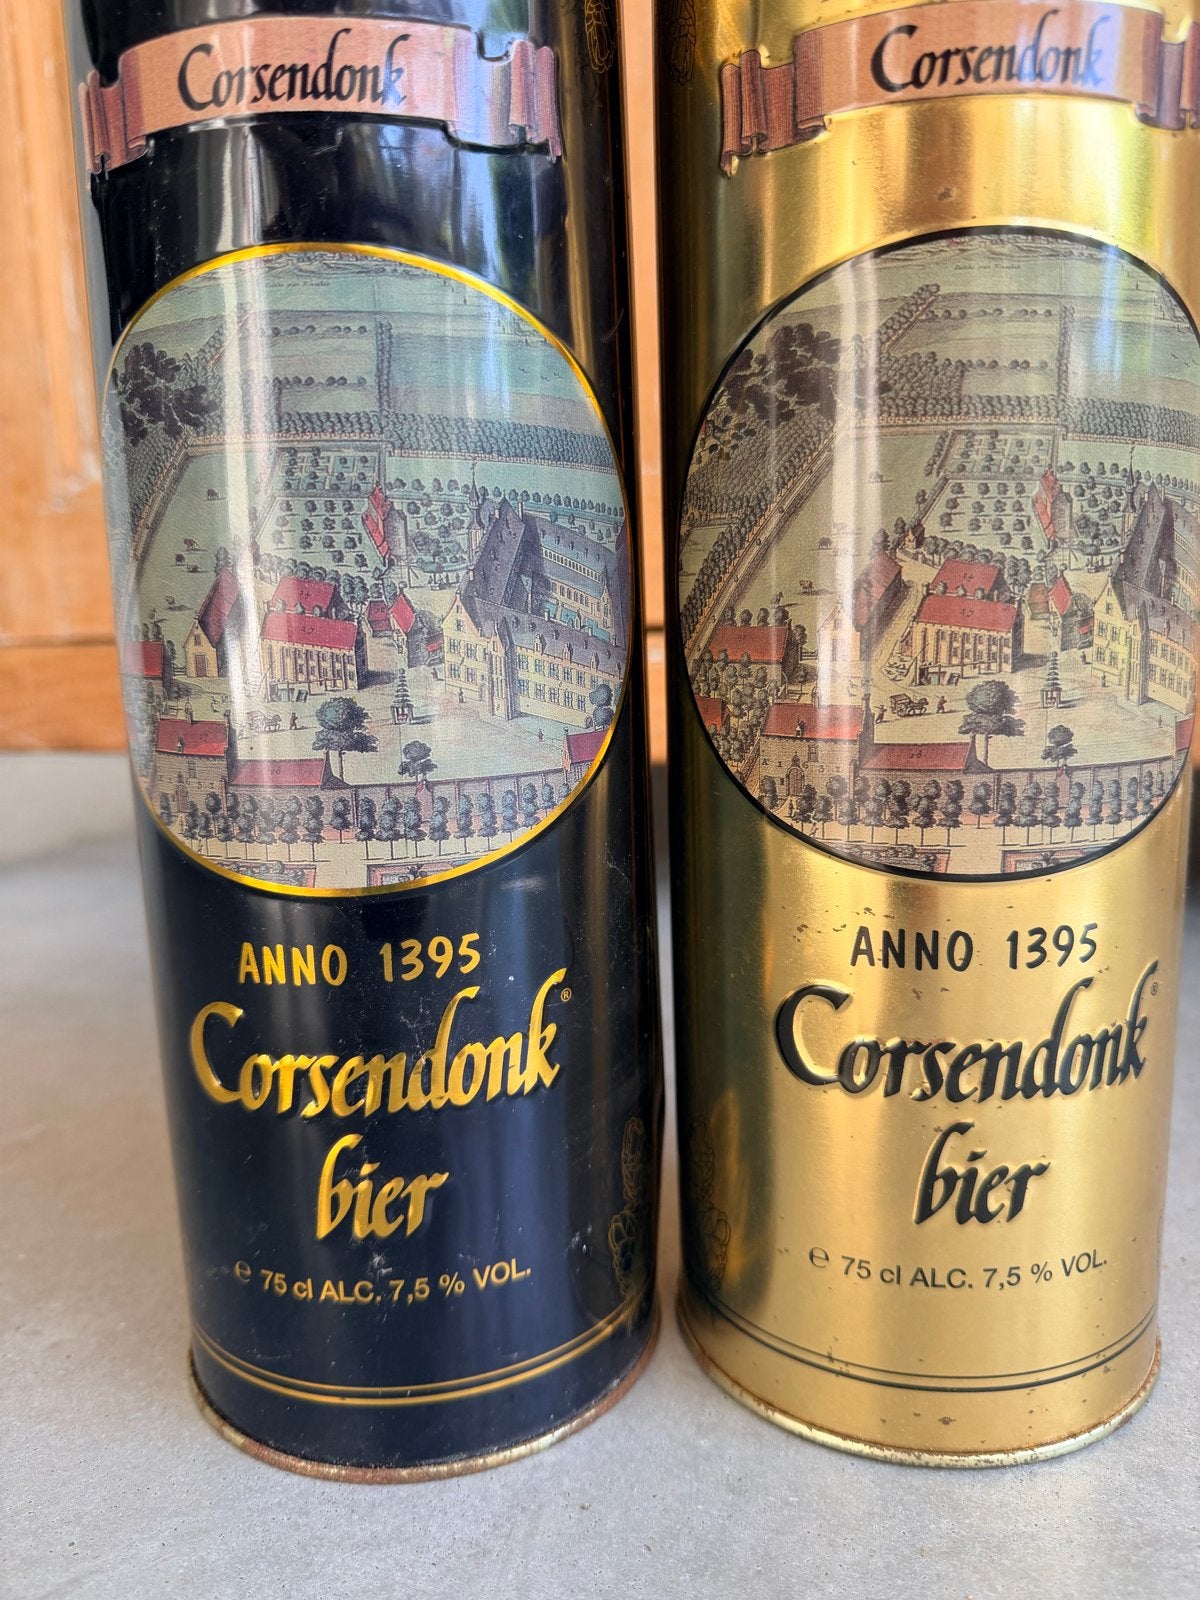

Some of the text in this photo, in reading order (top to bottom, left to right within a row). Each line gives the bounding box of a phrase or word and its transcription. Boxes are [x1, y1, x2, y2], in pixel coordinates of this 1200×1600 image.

[177, 28, 411, 112] Corsendonk
[869, 9, 1113, 93] Corsendonk
[238, 932, 482, 987] ANNO 1395
[850, 922, 1099, 972] ANNO 1395
[316, 1133, 449, 1241] bier
[913, 1121, 1051, 1226] bier
[260, 1269, 288, 1295] 75
[292, 1279, 314, 1300] cl
[320, 1278, 382, 1303] ALC.
[390, 1278, 431, 1306] 7,5
[438, 1273, 466, 1295] %
[473, 1256, 532, 1291] VOL.
[841, 1255, 872, 1280] 75
[880, 1266, 901, 1286] cl
[910, 1268, 974, 1289] ALC.
[982, 1266, 1022, 1291] 7,5
[1030, 1262, 1053, 1283] %
[1060, 1247, 1109, 1279] VOL.
